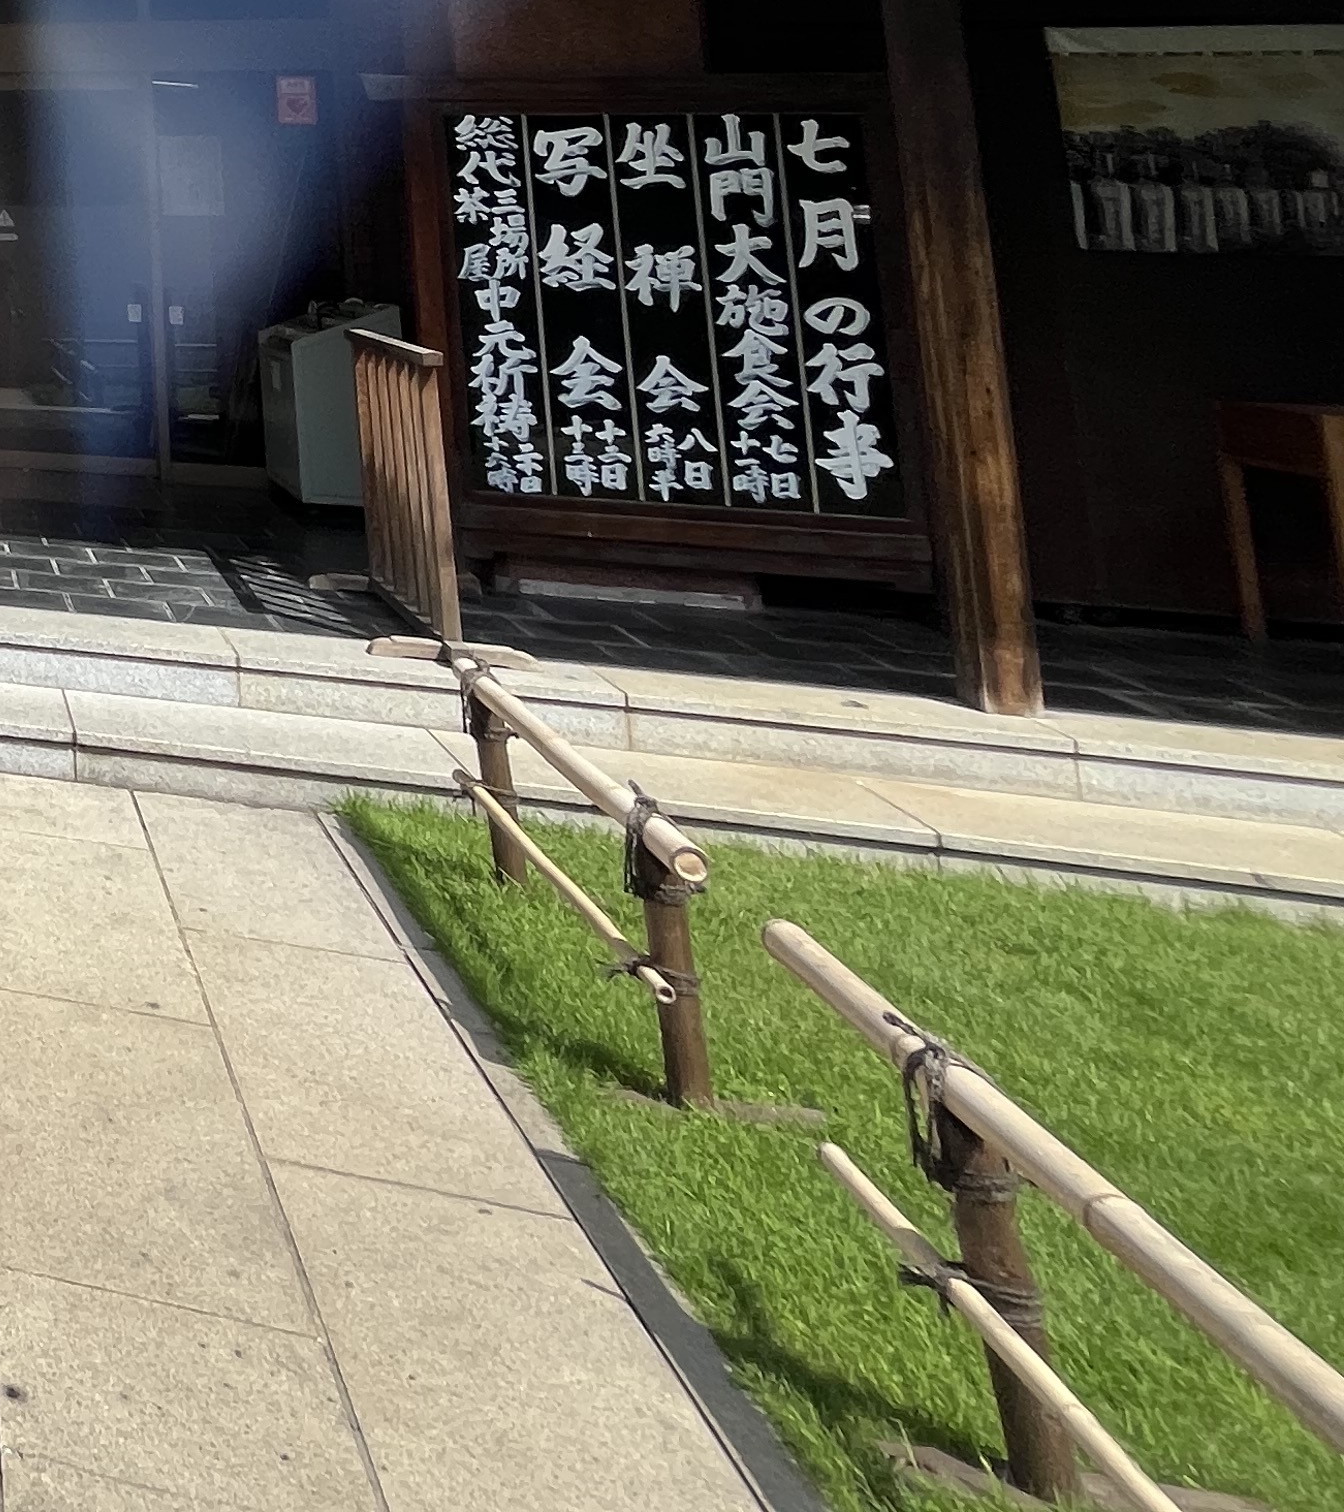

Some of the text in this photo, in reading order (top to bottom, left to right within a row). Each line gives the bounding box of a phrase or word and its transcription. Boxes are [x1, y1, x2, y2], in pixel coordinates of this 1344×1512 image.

[533, 126, 623, 412] 写経会
[787, 118, 895, 501] 七月の行事
[676, 427, 718, 490] 八日
[762, 434, 802, 499] 七日
